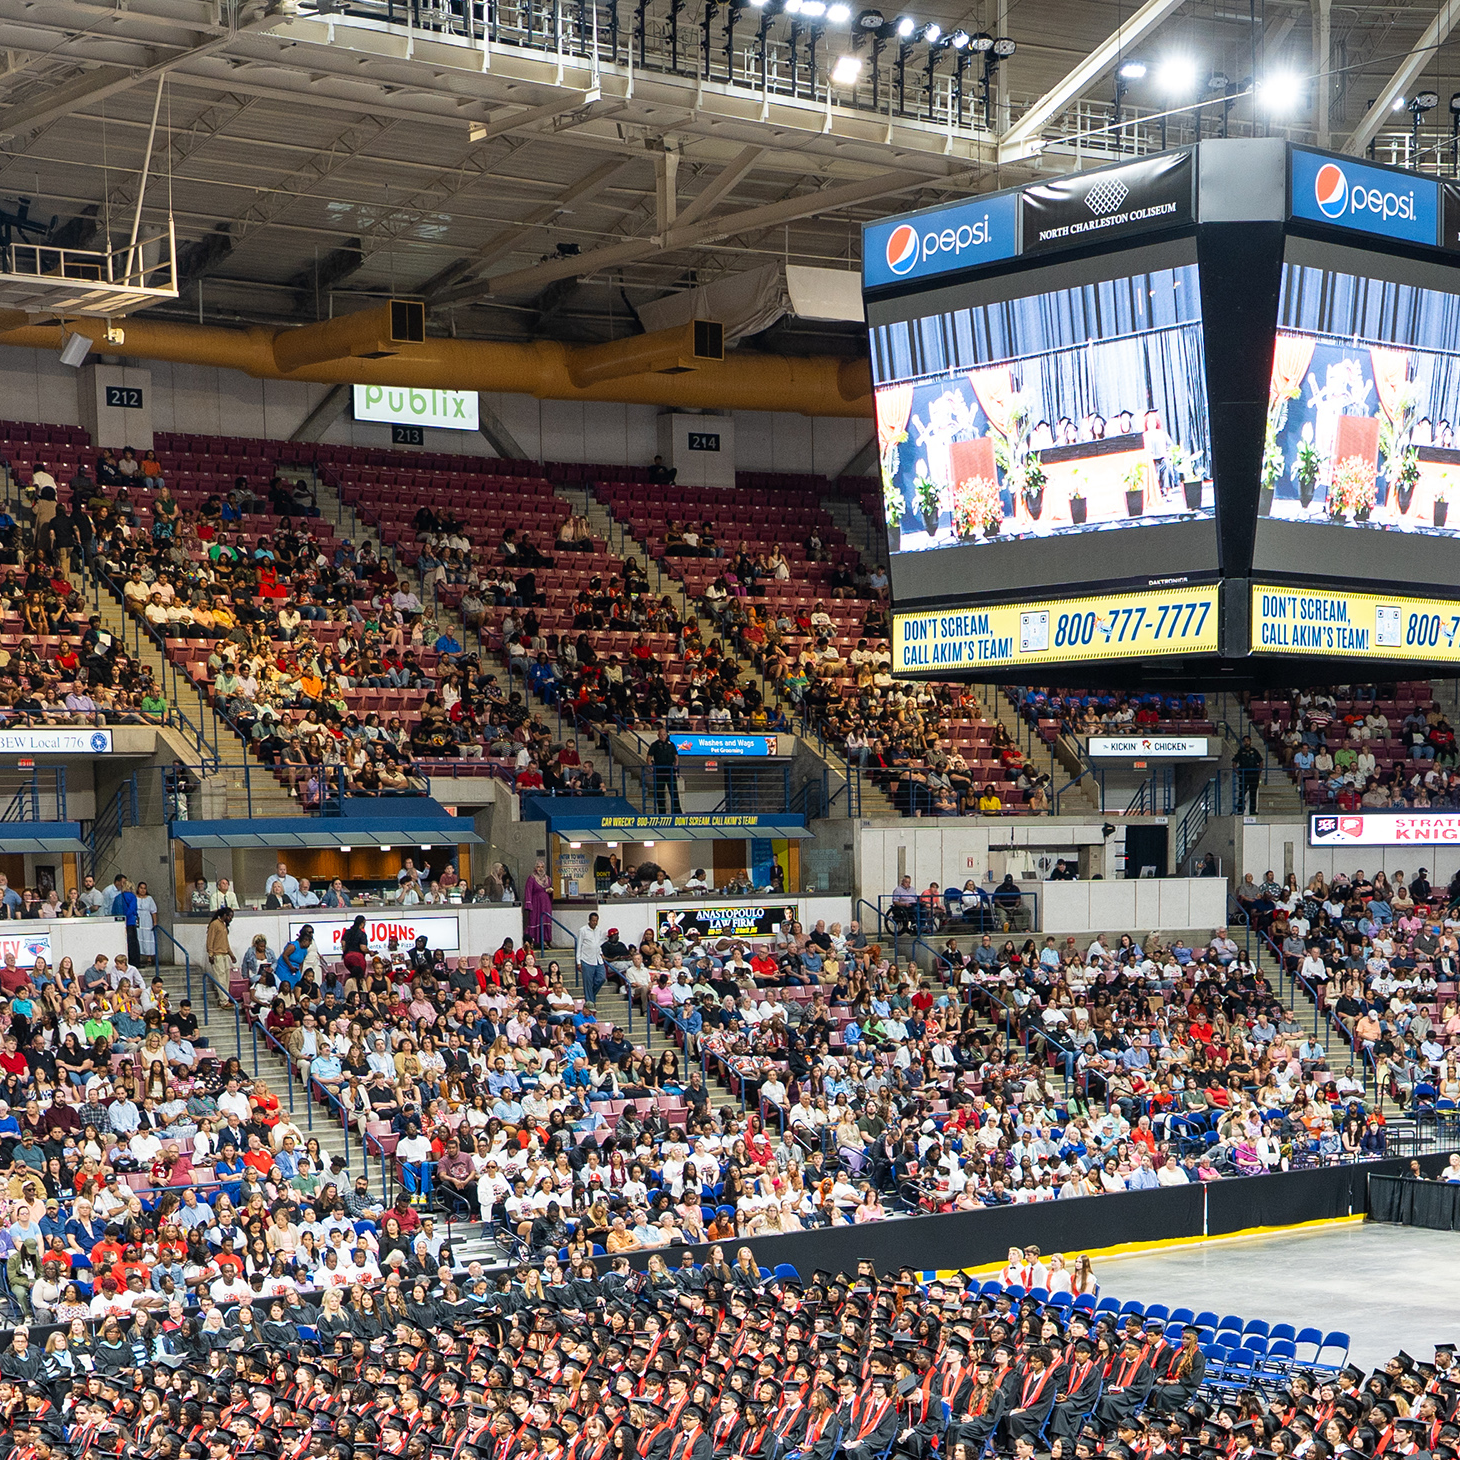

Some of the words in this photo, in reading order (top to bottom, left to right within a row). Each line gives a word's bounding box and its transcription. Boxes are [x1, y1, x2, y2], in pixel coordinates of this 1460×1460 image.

[1350, 185, 1414, 221] pepsi
[1039, 224, 1069, 242] NORTH
[1070, 212, 1128, 235] CHARLESTON
[1129, 201, 1177, 220] COLISEUM
[922, 214, 989, 262] pepsi
[111, 388, 140, 406] 212
[396, 429, 420, 444] 213
[692, 435, 716, 449] 214
[1262, 595, 1297, 619] DON'T
[1300, 598, 1351, 626] SCREAM,
[903, 618, 938, 641] DON'T
[940, 614, 994, 638] SCREAM,
[1261, 622, 1289, 647] CALL
[1292, 625, 1333, 649] AKIM'S
[1333, 628, 1369, 651] TEAM!
[903, 644, 930, 665] CALL
[931, 640, 975, 664] AKIM'S
[977, 637, 1013, 660] TEAM!
[30, 736, 60, 749] Local
[64, 736, 84, 749] 776
[698, 739, 724, 747] Washes
[724, 739, 736, 747] and
[737, 739, 755, 748] Wags
[1154, 742, 1187, 751] CHICKEN
[601, 817, 612, 827] CAR
[613, 817, 635, 827] WRECK?
[636, 817, 672, 827] 800-777-7777
[712, 816, 723, 826] CALL
[723, 816, 742, 826] AKIM'S
[742, 816, 758, 826] TEAM!
[696, 908, 764, 920] ANASTOPOULO
[370, 923, 415, 942] JOHNS
[709, 918, 731, 929] LAW
[732, 918, 756, 928] FIRM
